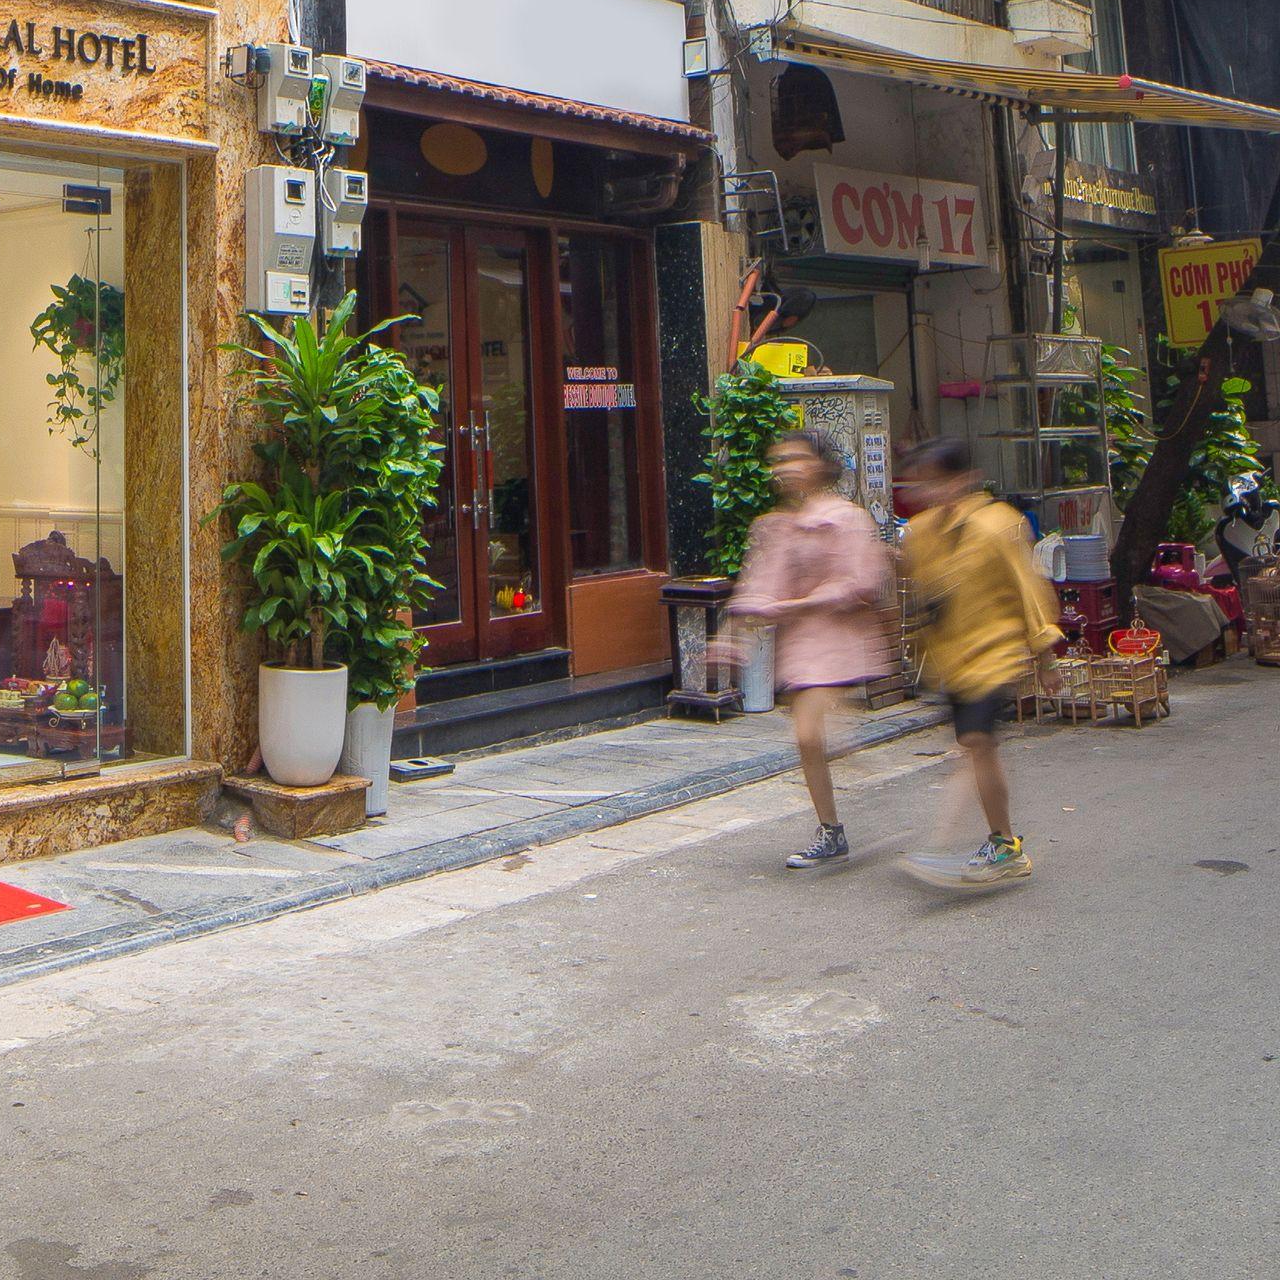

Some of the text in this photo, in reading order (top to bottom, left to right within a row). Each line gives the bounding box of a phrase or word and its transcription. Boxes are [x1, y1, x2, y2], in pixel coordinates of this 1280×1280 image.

[52, 25, 157, 74] HOTEL
[28, 72, 83, 101] Home
[832, 182, 976, 256] CƠM 17
[1170, 261, 1213, 298] CƠM
[566, 366, 618, 380] WELCOME TO
[588, 384, 618, 409] BOUTIQUE
[617, 383, 637, 408] HOTEL
